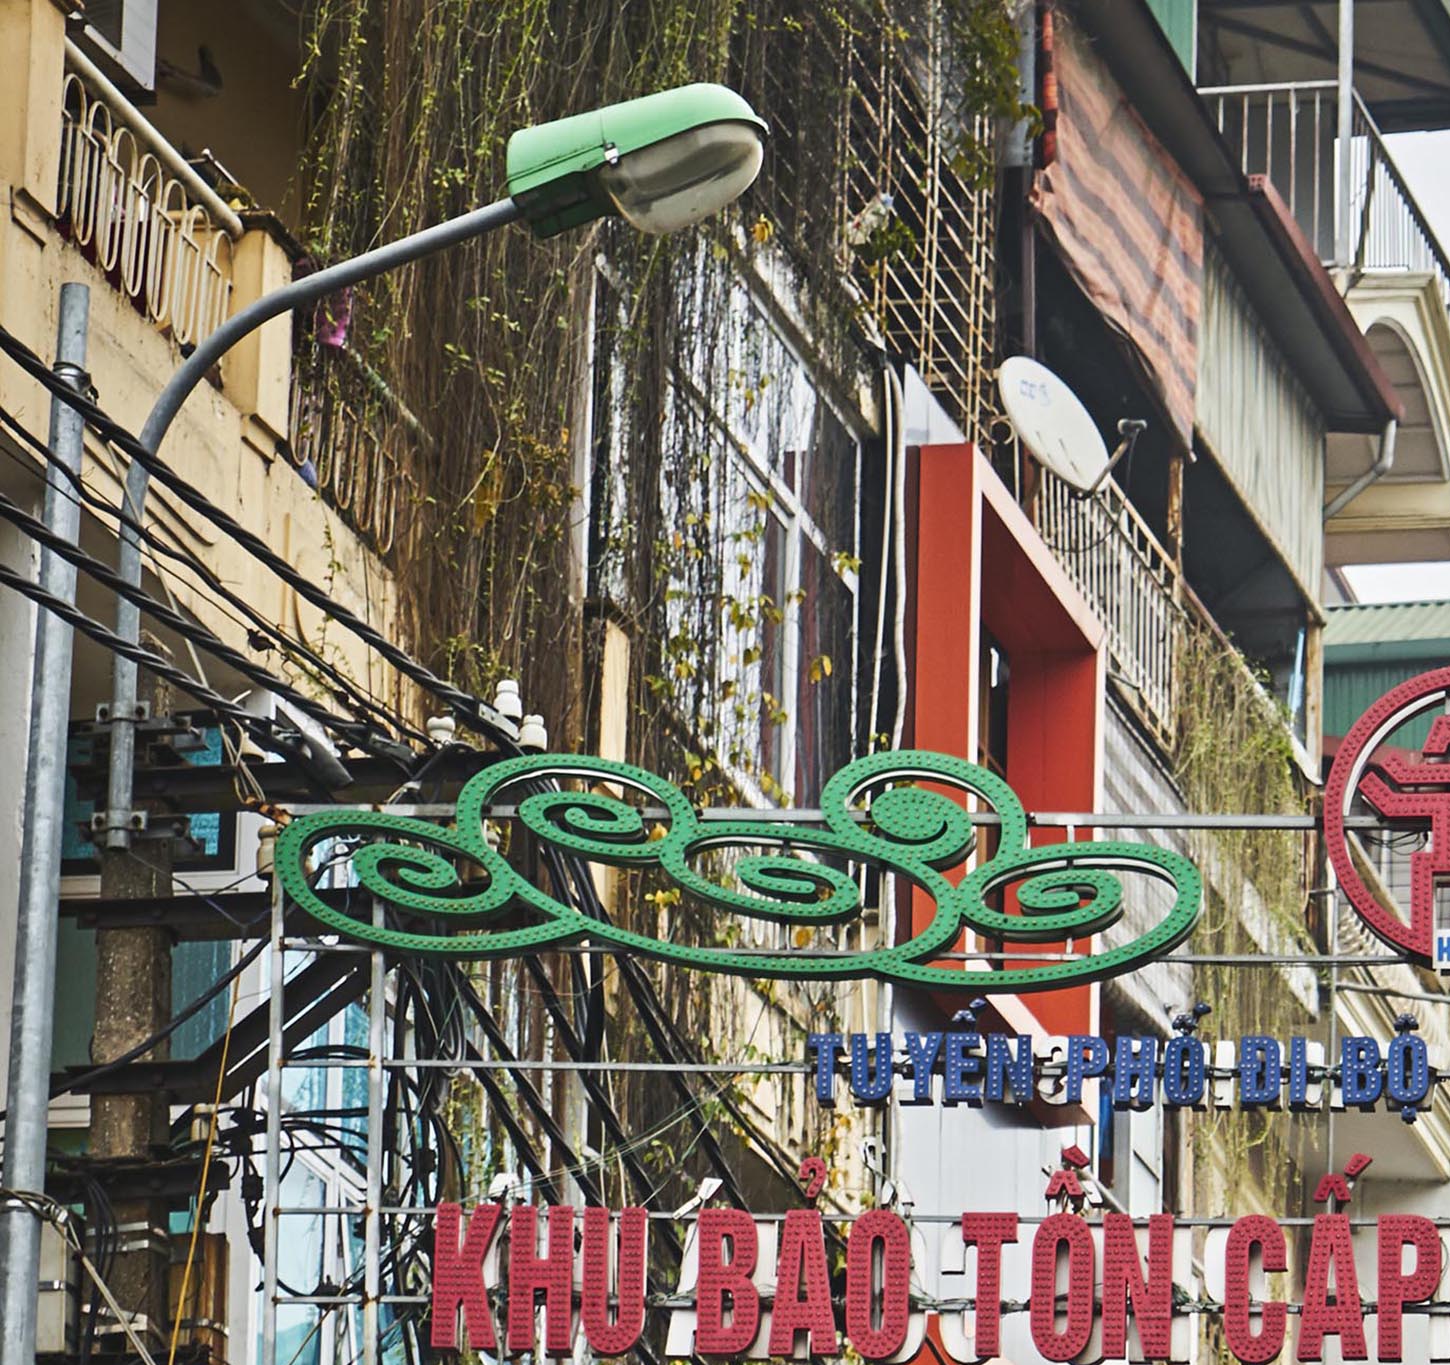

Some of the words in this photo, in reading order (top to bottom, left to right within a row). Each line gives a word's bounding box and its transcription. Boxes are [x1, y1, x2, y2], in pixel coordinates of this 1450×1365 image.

[1341, 1013, 1430, 1124] BỘ
[430, 1200, 649, 1356] KHU
[695, 1157, 910, 1362] BẢO
[960, 1144, 1177, 1365] TỒN
[1224, 1152, 1441, 1365] CẤP
